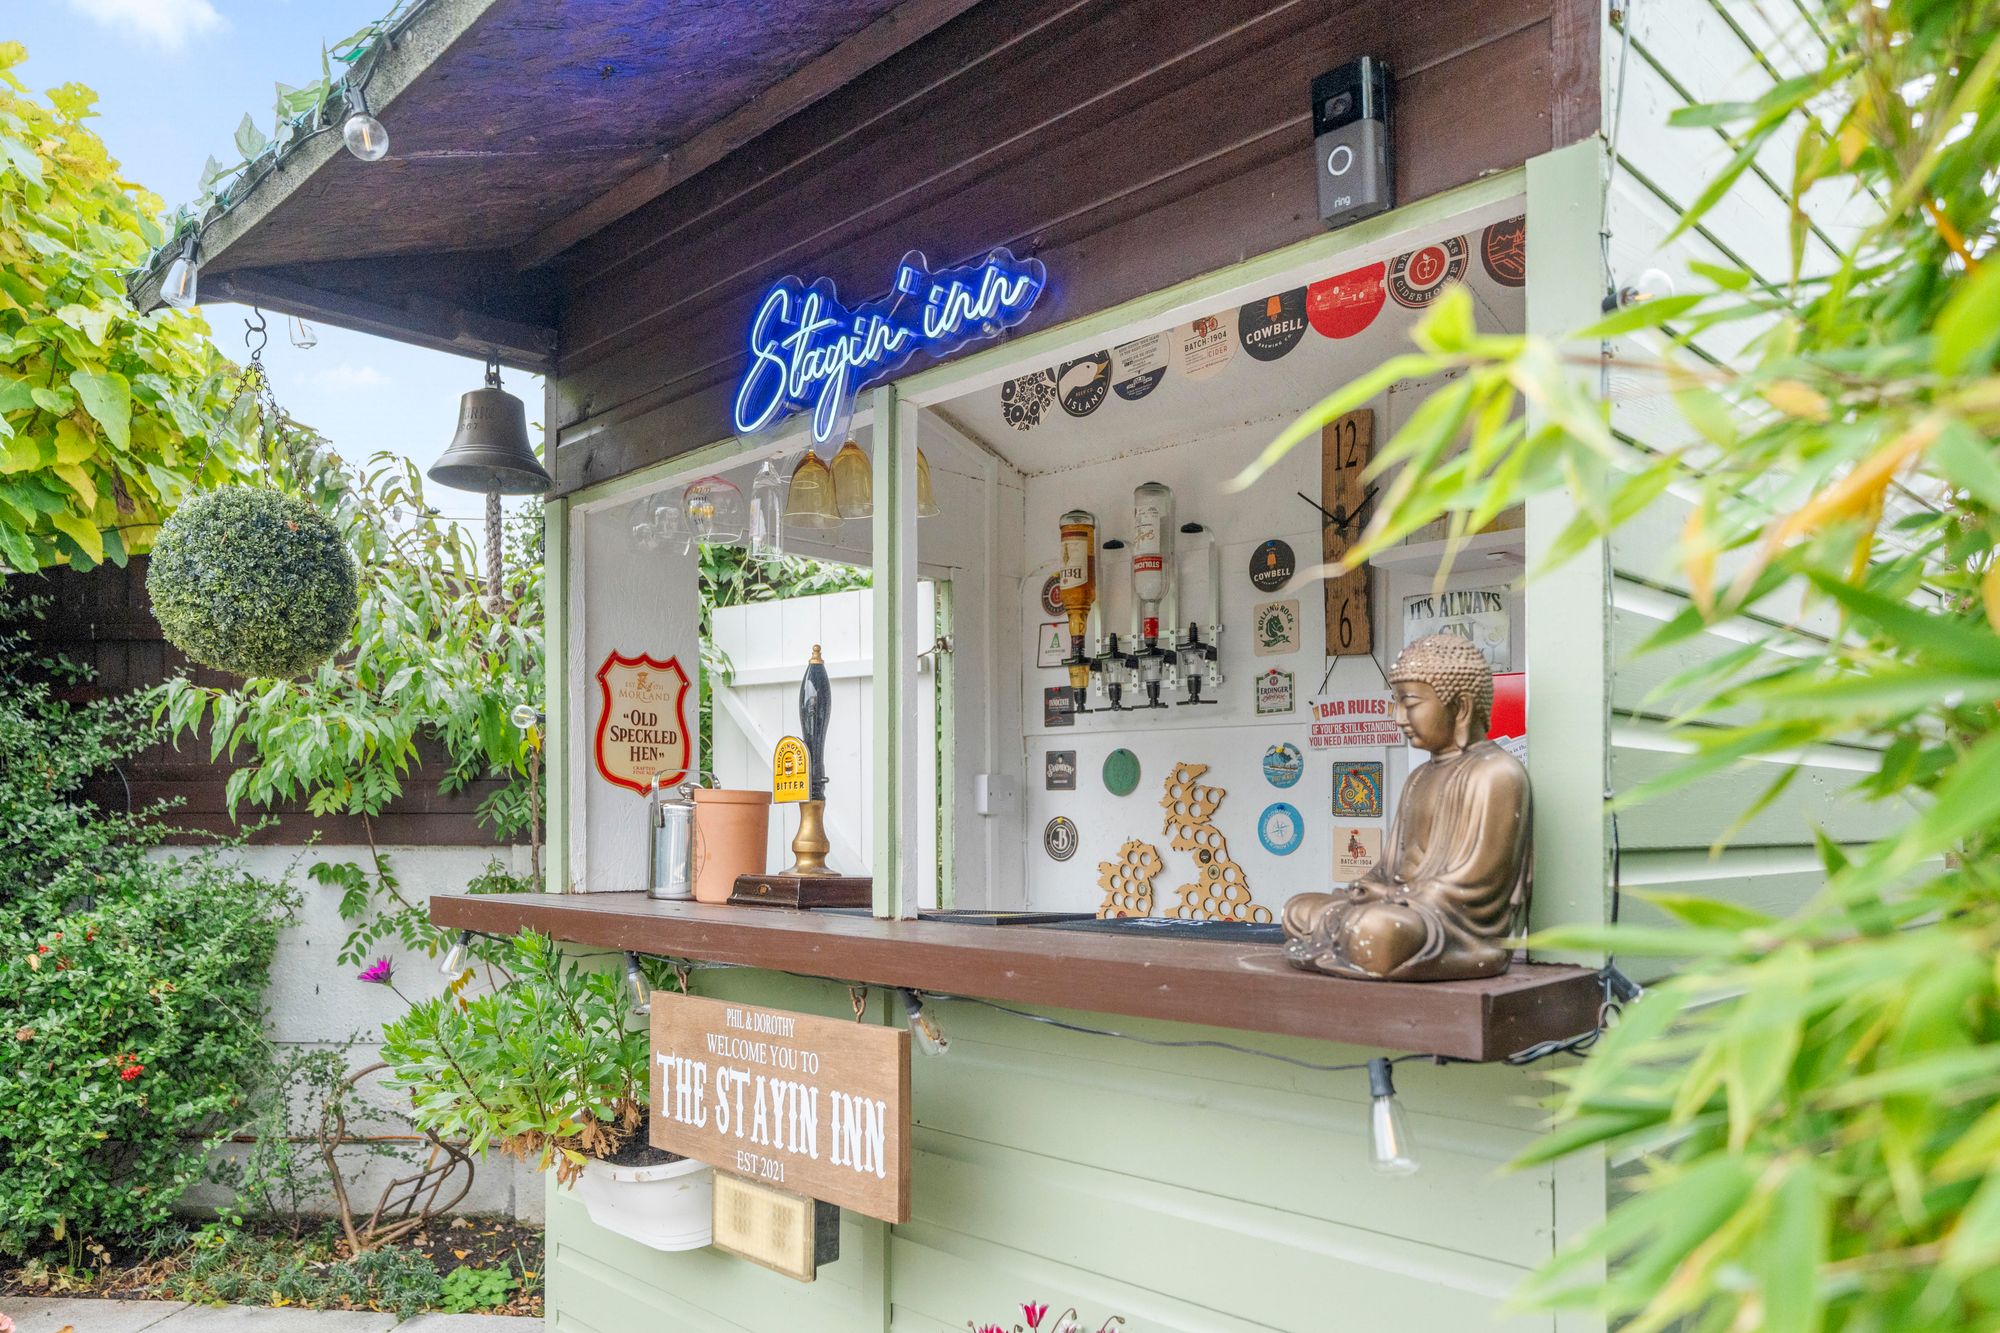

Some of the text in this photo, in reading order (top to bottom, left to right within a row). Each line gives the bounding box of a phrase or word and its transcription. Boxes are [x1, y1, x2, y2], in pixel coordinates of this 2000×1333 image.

[1334, 195, 1351, 208] ring
[923, 265, 1030, 338] inn
[1245, 318, 1303, 345] COWBELL
[1208, 346, 1228, 358] CIDER
[1066, 386, 1104, 411] ISLAND
[1334, 420, 1358, 471] 12
[1253, 568, 1291, 582] COWBELL
[1258, 603, 1294, 631] ROLLING ROCK
[1410, 591, 1502, 620] IT'S ALWAYS
[1340, 598, 1352, 649] 6
[619, 689, 670, 703] MORLAND
[1260, 686, 1289, 695] ERDINGER
[1321, 699, 1386, 717] BAR RULES
[610, 725, 677, 745] SPECKLED
[1309, 733, 1401, 747] YOU NEED ANOTHER DRINK!
[1313, 721, 1397, 734] IF YOU'RE STILL STANDING
[776, 781, 805, 791] BITTER
[726, 1008, 795, 1039] PHIL & DOROTHY
[706, 1033, 819, 1075] WELCOME YOU TO
[656, 1050, 887, 1179] THE STAYIN INN
[736, 1150, 785, 1184] EST 2021
